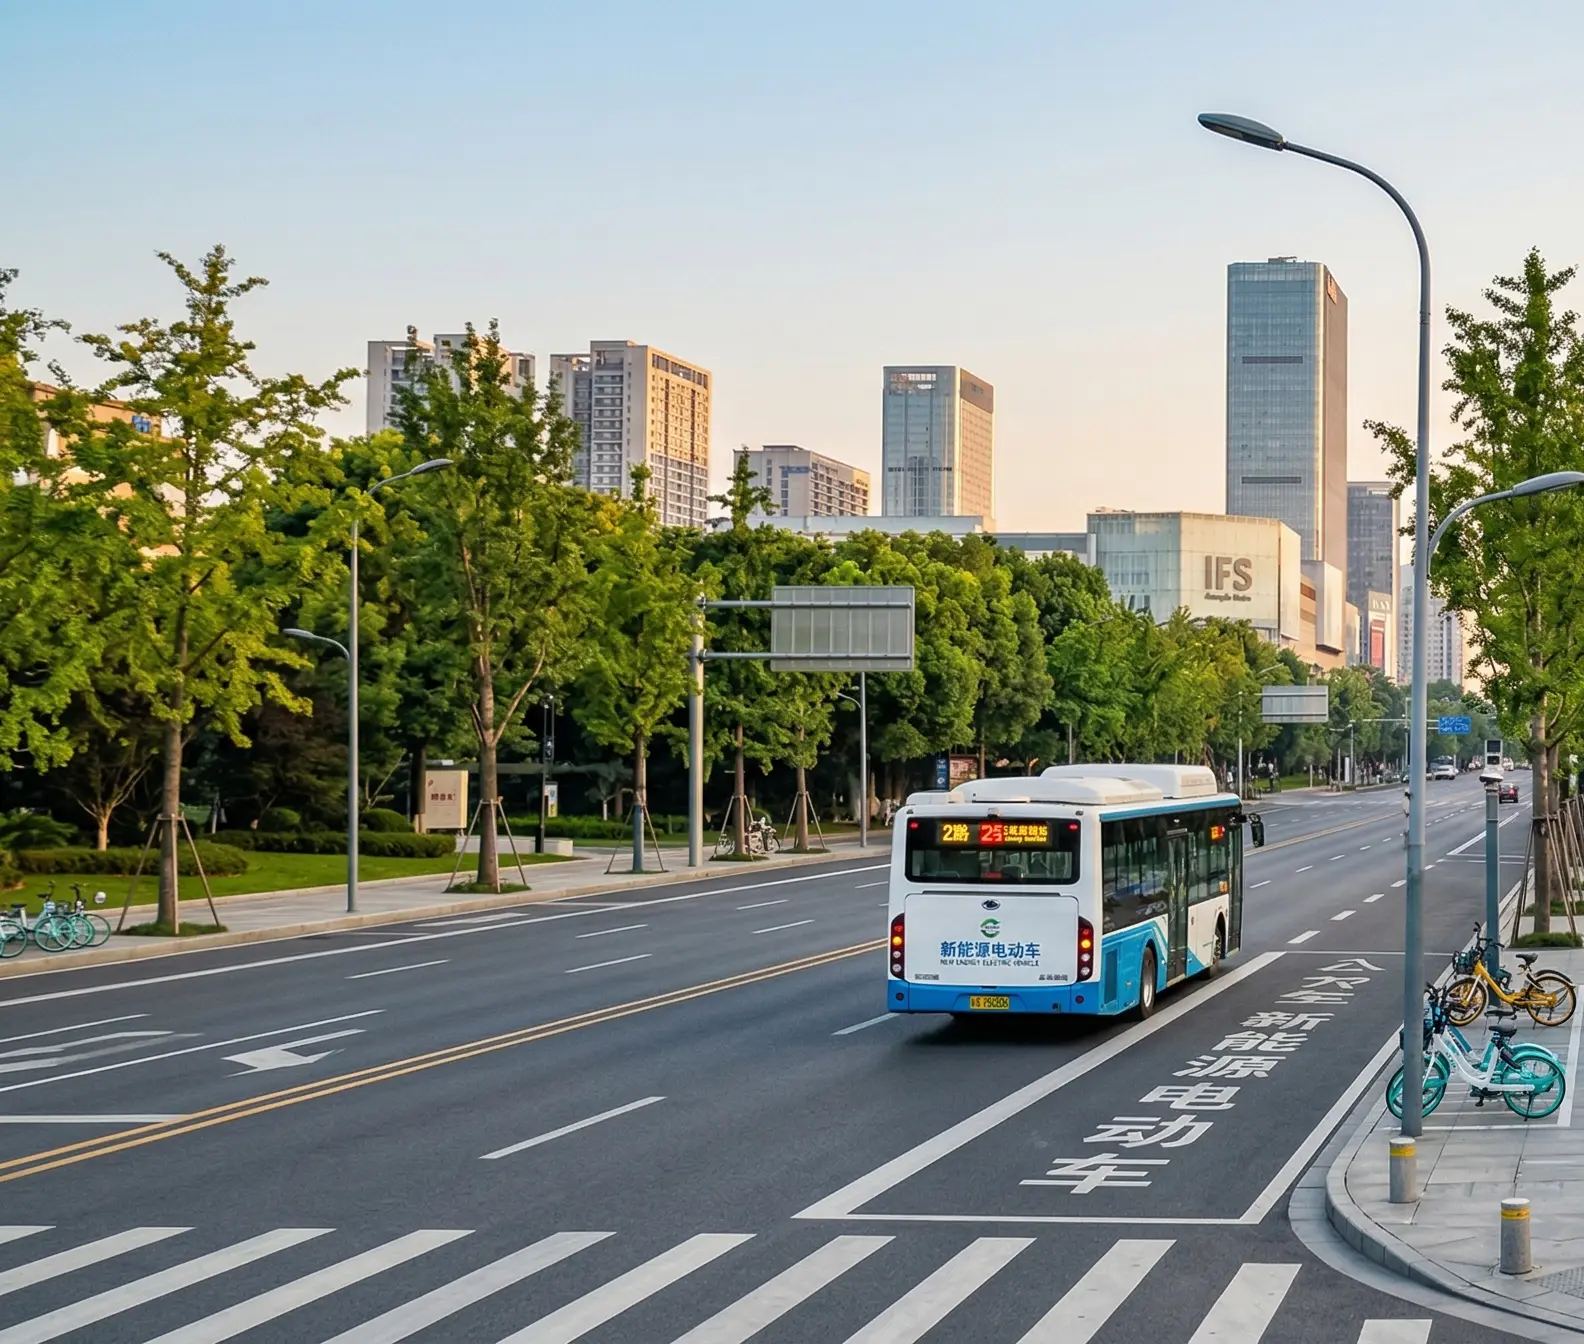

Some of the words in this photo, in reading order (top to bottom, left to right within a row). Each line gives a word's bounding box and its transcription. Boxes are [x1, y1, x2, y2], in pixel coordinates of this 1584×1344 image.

[1204, 555, 1253, 592] IFS
[940, 941, 1041, 959] 新能源电动车
